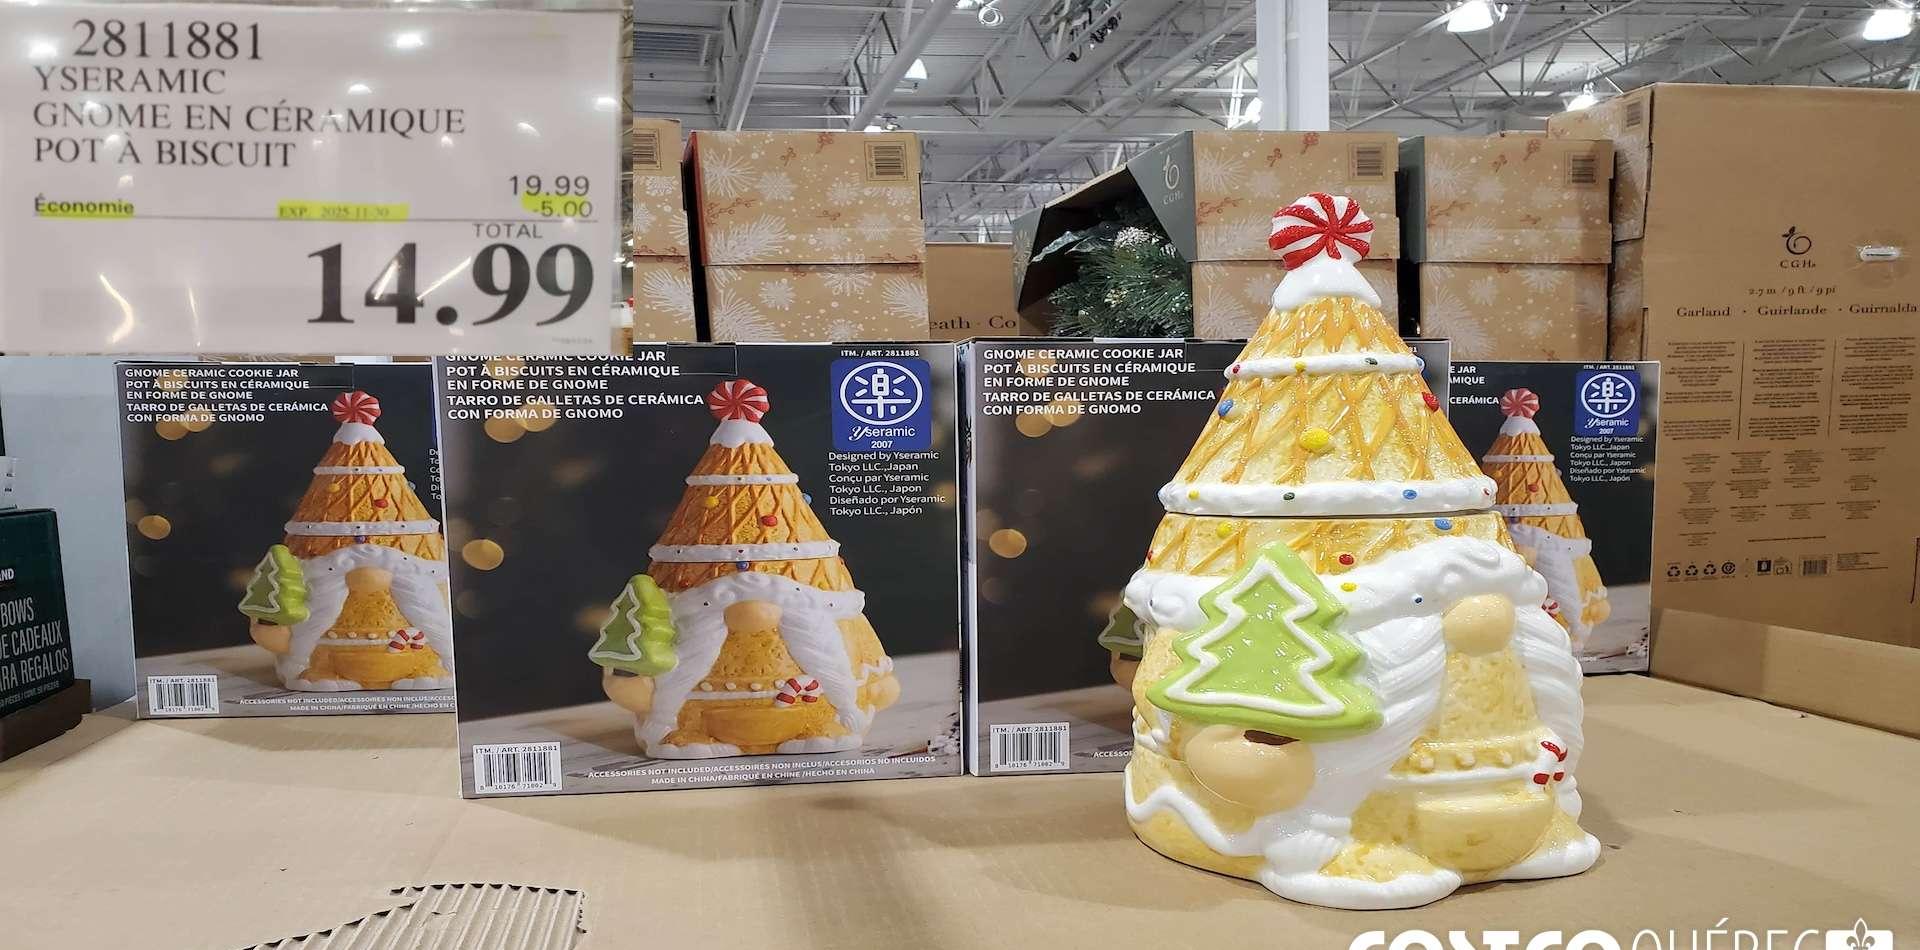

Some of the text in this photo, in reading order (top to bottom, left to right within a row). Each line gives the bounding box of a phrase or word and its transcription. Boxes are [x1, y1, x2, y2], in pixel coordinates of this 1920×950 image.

[73, 19, 264, 60] 2811881
[33, 66, 227, 95] YSERAMIC
[33, 99, 466, 138] GNOME EN CÉRAMIQUE
[34, 130, 297, 168] POT À BISCUIT
[508, 175, 591, 198] 19.99
[34, 193, 135, 216] Économie
[532, 200, 593, 218] -5.00
[473, 223, 543, 240] TOTAL
[306, 242, 595, 326] 14.99
[1676, 303, 1918, 317] Garland Guirlande Guirnalda
[637, 351, 666, 361] JAR
[983, 349, 1183, 360] GNOME CERAMIC COOKIE JAR
[125, 369, 299, 378] GNOME CERAMIC COOKIE JAR
[446, 363, 680, 378] POT À BISCUITS EN CÉRAMIQUE
[984, 361, 1196, 375] POT À BISCUITS EN CÉRAMIQUE
[1458, 366, 1476, 374] JAR
[126, 378, 310, 391] POT À BISCUITS EN CÉRAMIQUE
[447, 380, 609, 390] EN FORME DE GNOME
[984, 377, 1129, 387] EN FORME DE GNOME
[127, 391, 253, 400] EN FORME DE GNOME
[446, 392, 704, 406] TARRO DE GALLETAS DE CERÁMICA
[983, 388, 1215, 402] TARRO DE GALLETAS DE CERÁMICA
[1449, 395, 1499, 405] CERÁMICA
[126, 400, 329, 412] TARRO DE GALLETAS DE CERÁMICA
[983, 404, 1141, 416] CON FORMA DE GNOMO
[127, 413, 265, 423] CON FORMA DE GNOMO
[447, 408, 624, 420] CON FORMA DE GNOMO
[849, 426, 916, 441] Yseramic
[828, 451, 940, 462] Designed by Yseramic
[829, 473, 930, 484] Conçu par Yseramic
[829, 484, 922, 495] Tokyo LLC., Japon
[830, 495, 946, 506] Diseñado por Yseramic
[830, 505, 923, 517] Tokyo LLC., Japón
[0, 597, 34, 628] BOWS
[0, 620, 63, 660] E CADEAUX
[20, 647, 69, 685] REGALOS
[588, 769, 647, 778] ACCESSORIES
